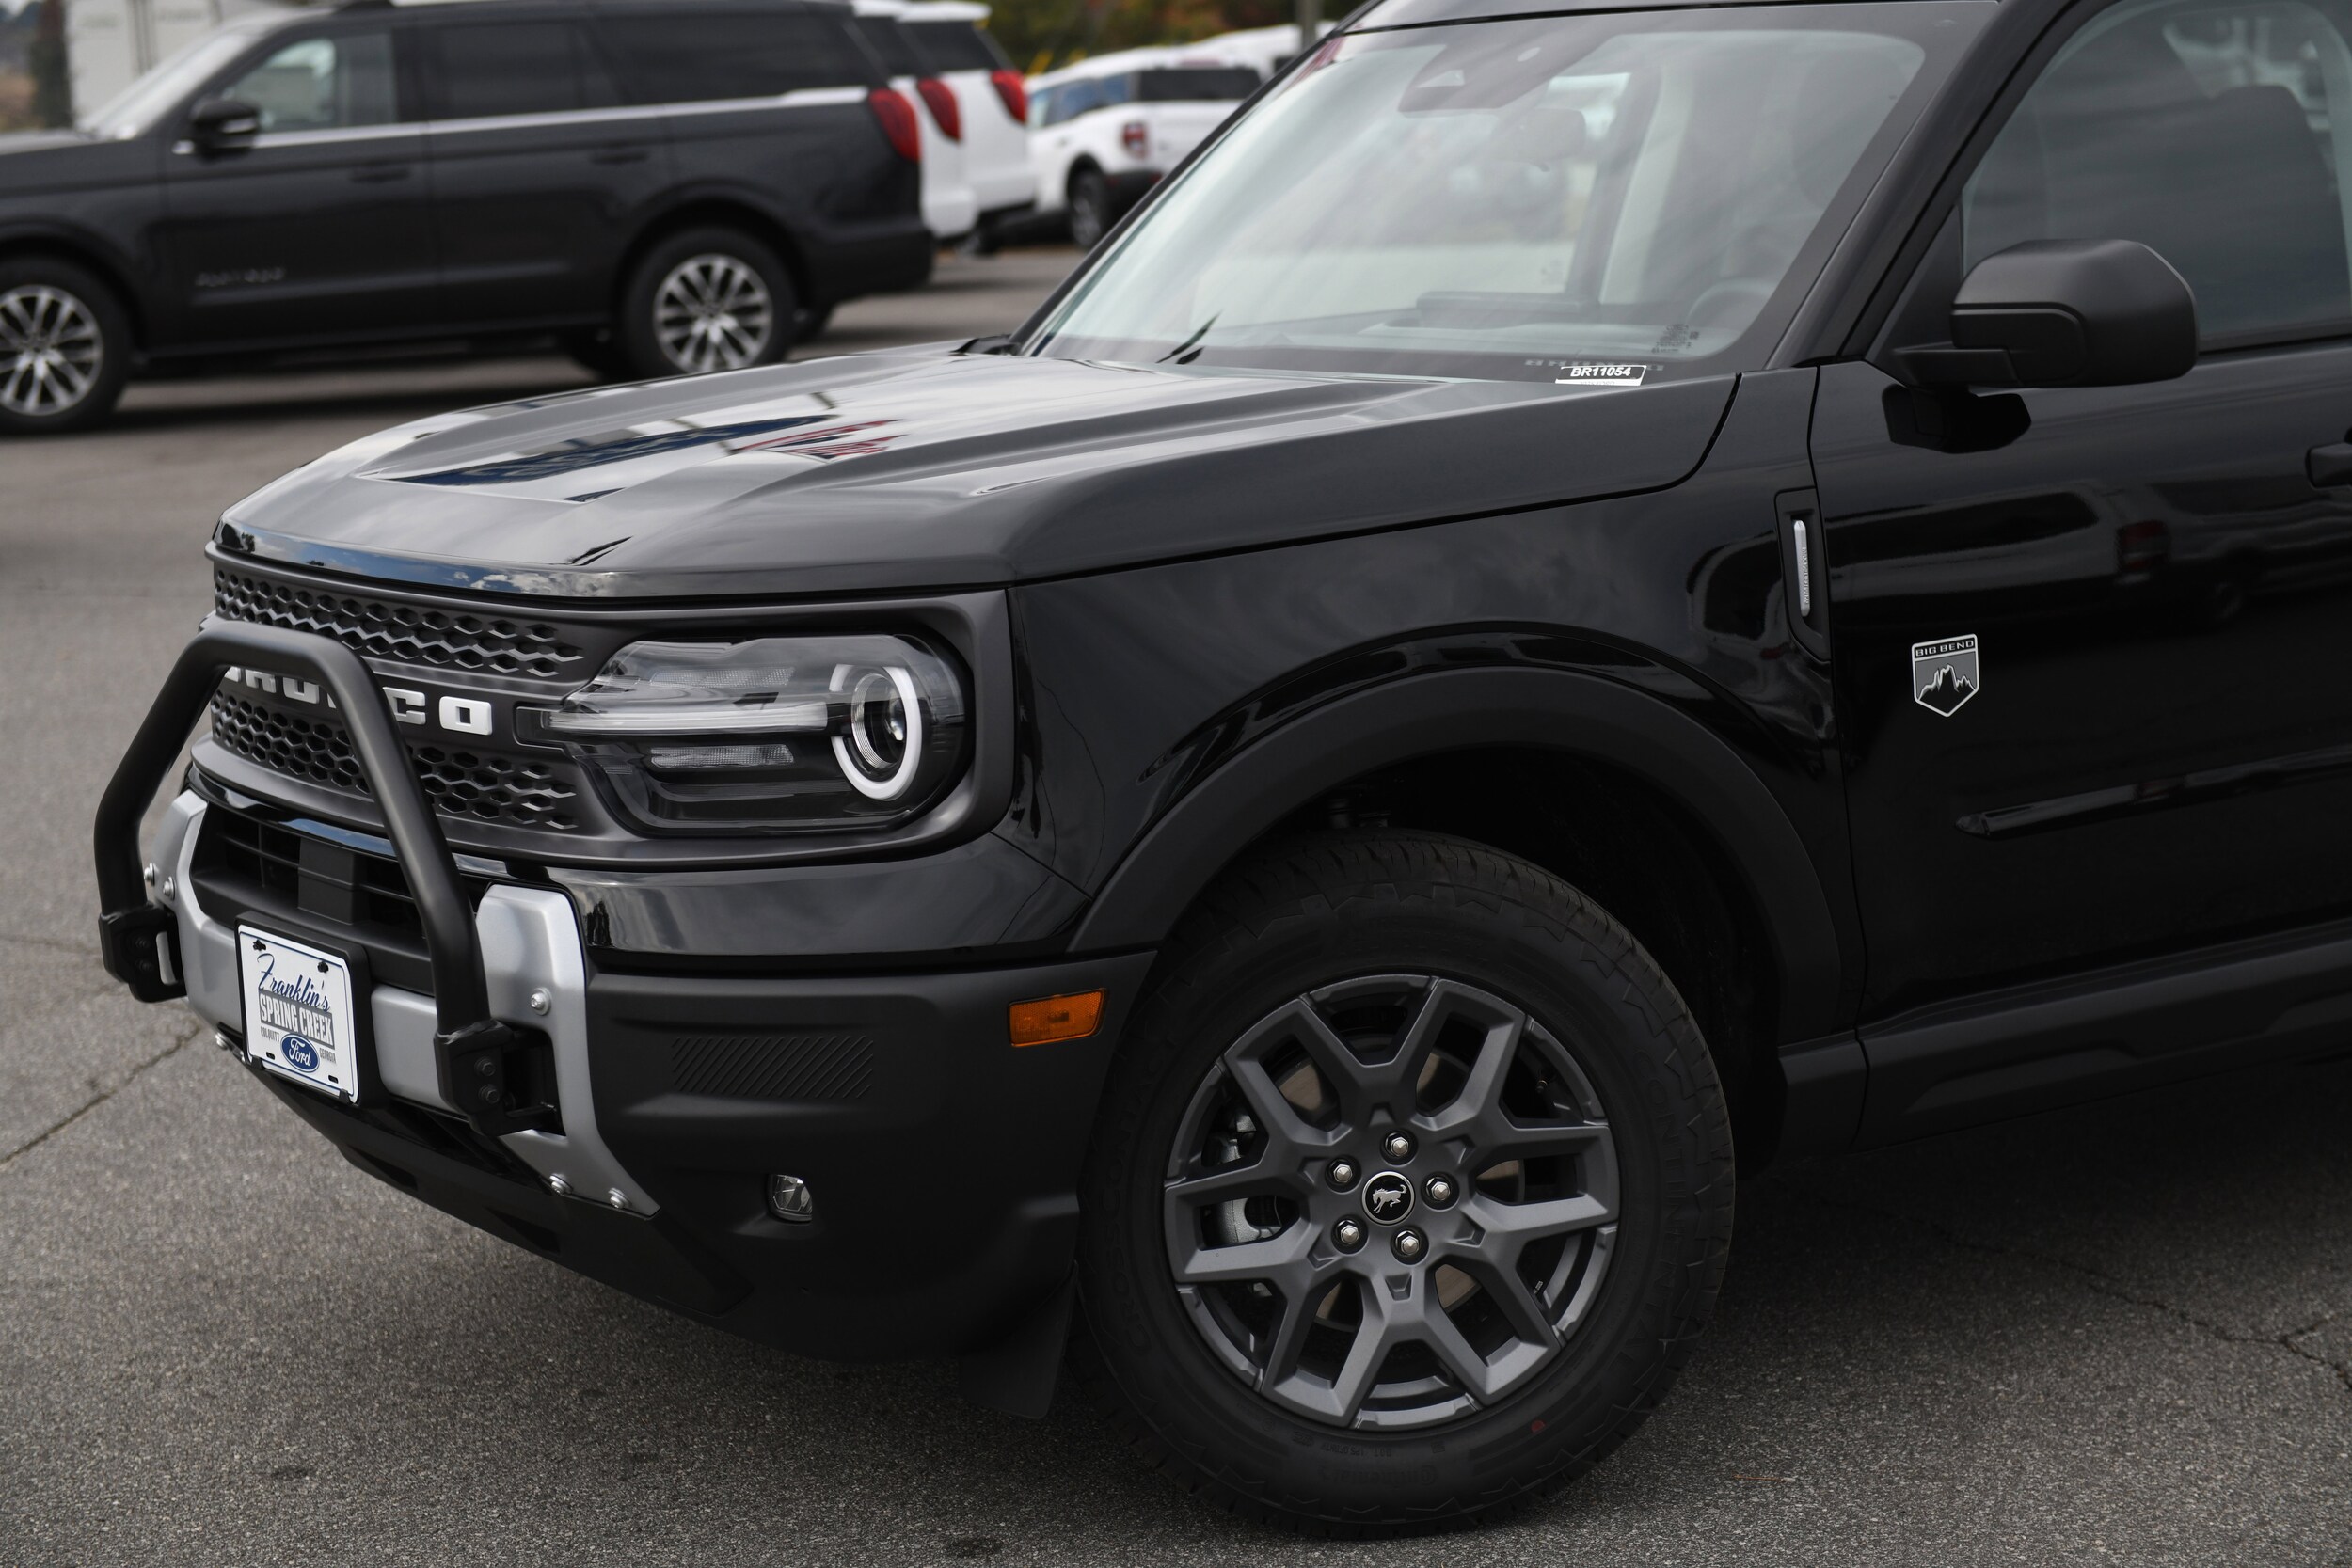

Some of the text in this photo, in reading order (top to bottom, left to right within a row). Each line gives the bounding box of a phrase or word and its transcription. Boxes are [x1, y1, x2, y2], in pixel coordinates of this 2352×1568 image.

[1570, 366, 1631, 377] BR11054
[1915, 640, 1974, 657] BIG BEND
[224, 666, 493, 736] ROCO
[257, 953, 331, 1012] Franklin's
[260, 993, 334, 1046] SPRING CREEK
[260, 1026, 280, 1042] COLQUITT
[288, 1037, 312, 1067] Ford
[1610, 1049, 1688, 1371] CONTINENTAL
[1328, 1465, 1438, 1491] Continental
